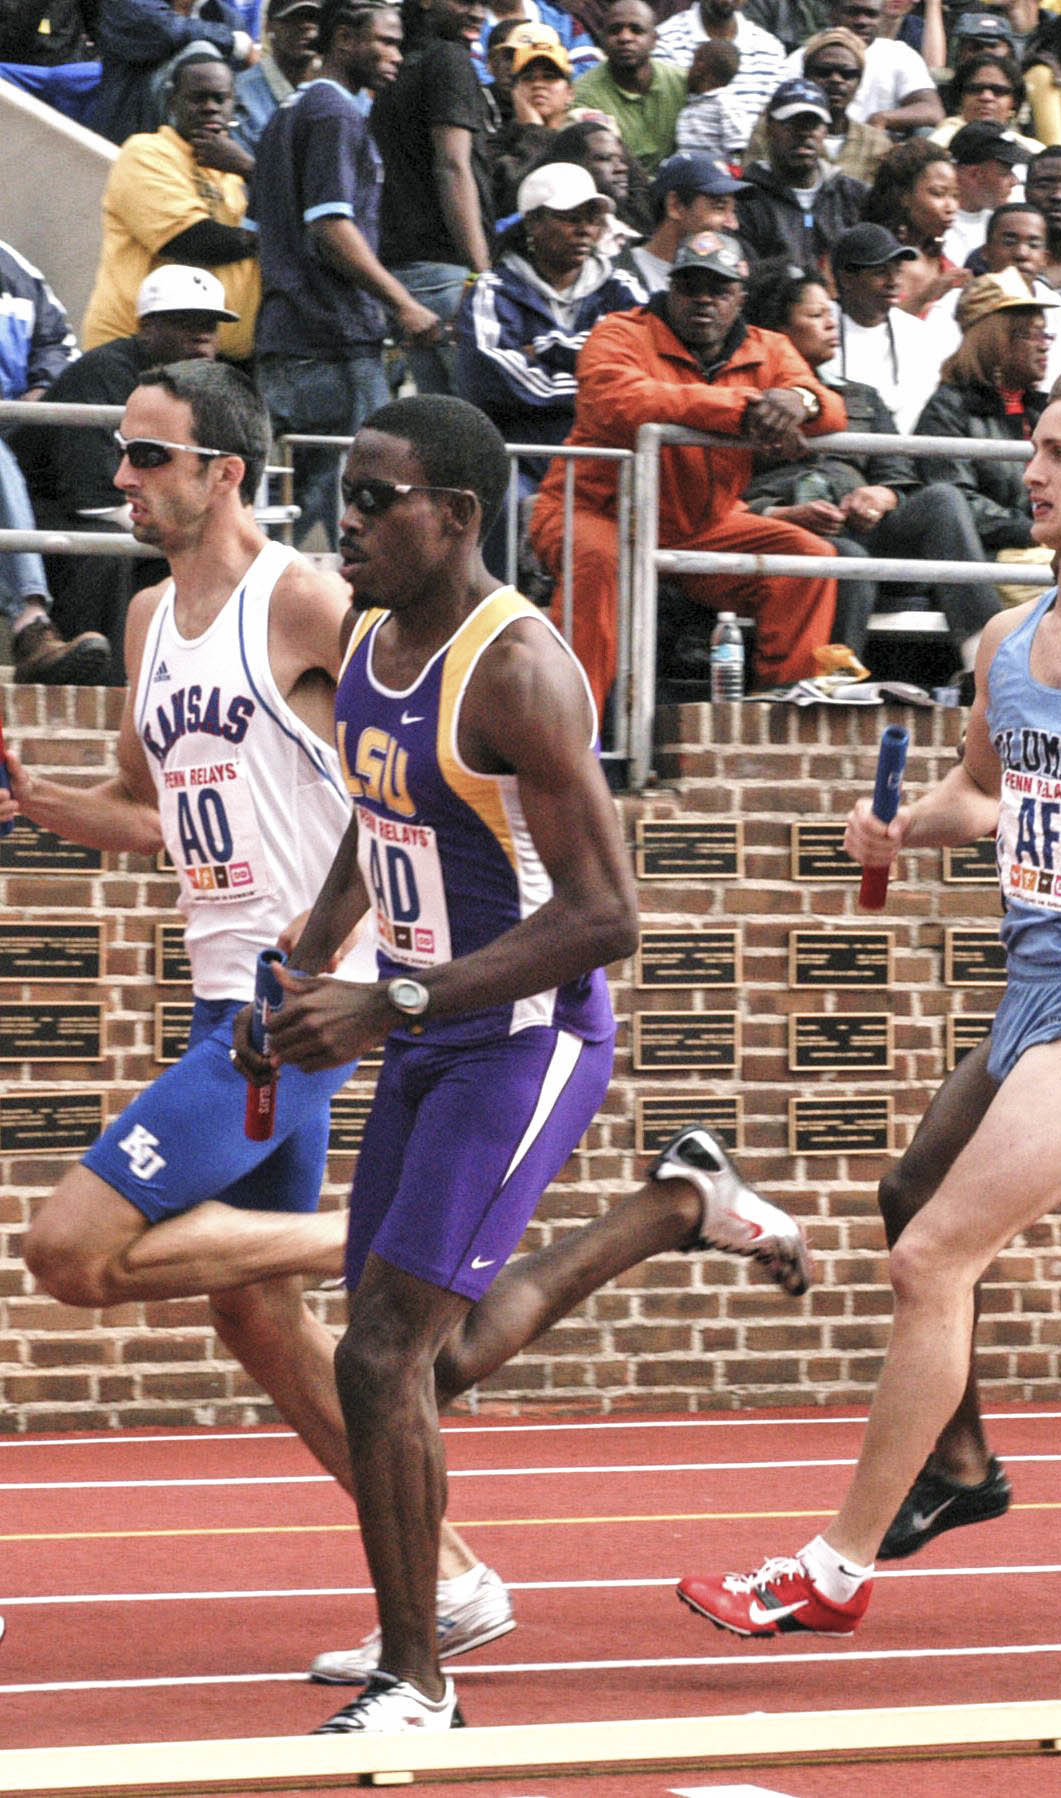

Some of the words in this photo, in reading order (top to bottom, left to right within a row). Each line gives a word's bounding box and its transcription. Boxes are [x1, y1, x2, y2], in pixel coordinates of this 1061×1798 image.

[143, 685, 255, 768] KANSAS
[190, 762, 237, 785] RELAYS
[336, 721, 417, 818] LSU
[1005, 772, 1032, 793] PENN
[1015, 797, 1060, 870] AF
[370, 838, 421, 923] AD
[117, 1123, 167, 1180] KU
